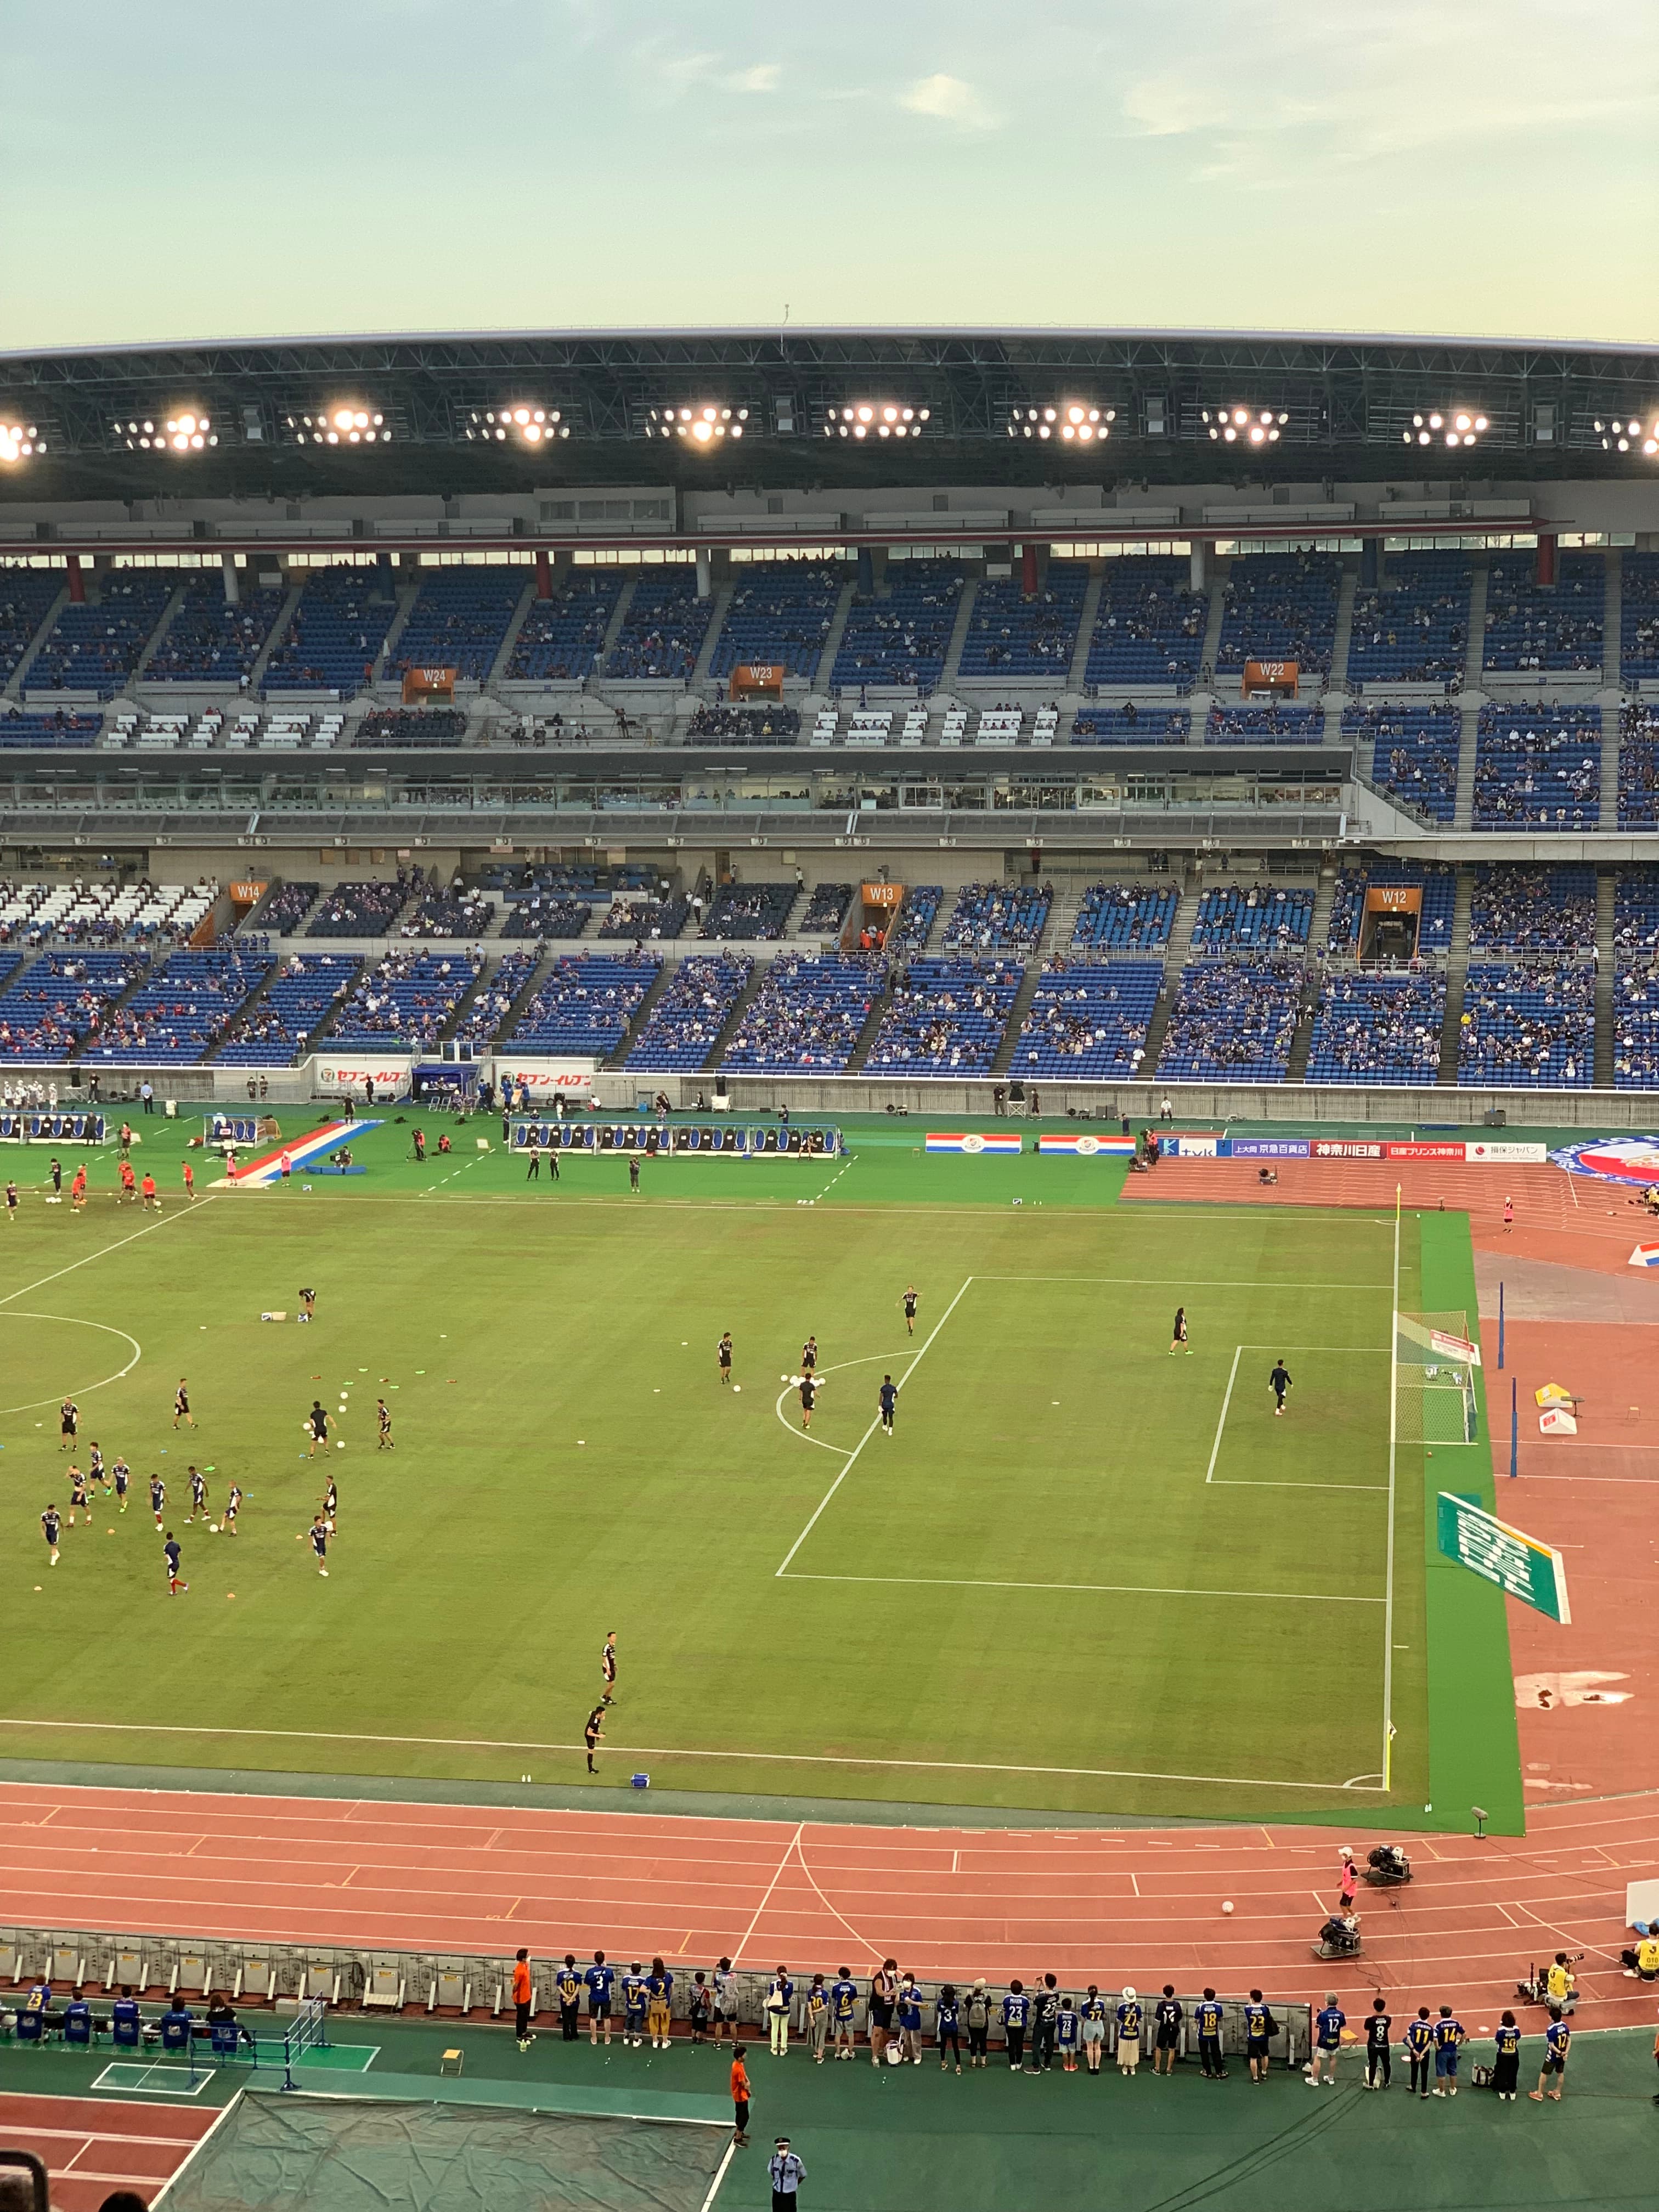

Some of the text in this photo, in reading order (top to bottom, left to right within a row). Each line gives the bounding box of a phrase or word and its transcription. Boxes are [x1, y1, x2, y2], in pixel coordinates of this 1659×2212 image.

[423, 670, 446, 682] W24
[749, 667, 773, 679] W23
[1260, 663, 1284, 676] W22
[237, 886, 261, 898] W14
[870, 888, 894, 900] W13
[1381, 891, 1407, 904] W12
[1235, 1144, 1307, 1154] 上大岡 京急百貨店
[1317, 1143, 1381, 1157] 神奈川日産
[1391, 1147, 1463, 1156] 日産プリンス神奈川
[1491, 1146, 1538, 1154] 損保ジャパン
[563, 1980, 575, 1993] 10
[596, 1976, 603, 1989] 3
[658, 1982, 665, 1995] 2
[27, 1992, 43, 2007] 23
[627, 1987, 640, 2000] 17
[841, 1993, 849, 2006] 6
[944, 2009, 952, 2022] 3
[1009, 2006, 1023, 2021] 23
[1042, 2002, 1057, 2017] 23
[1062, 2020, 1071, 2031] 23
[1203, 2013, 1217, 2027] 18
[1250, 2016, 1265, 2029] 23
[1328, 2018, 1340, 2033] 12
[1376, 2025, 1385, 2039] 8
[1415, 2028, 1429, 2044] 11
[1444, 2028, 1456, 2043] 14
